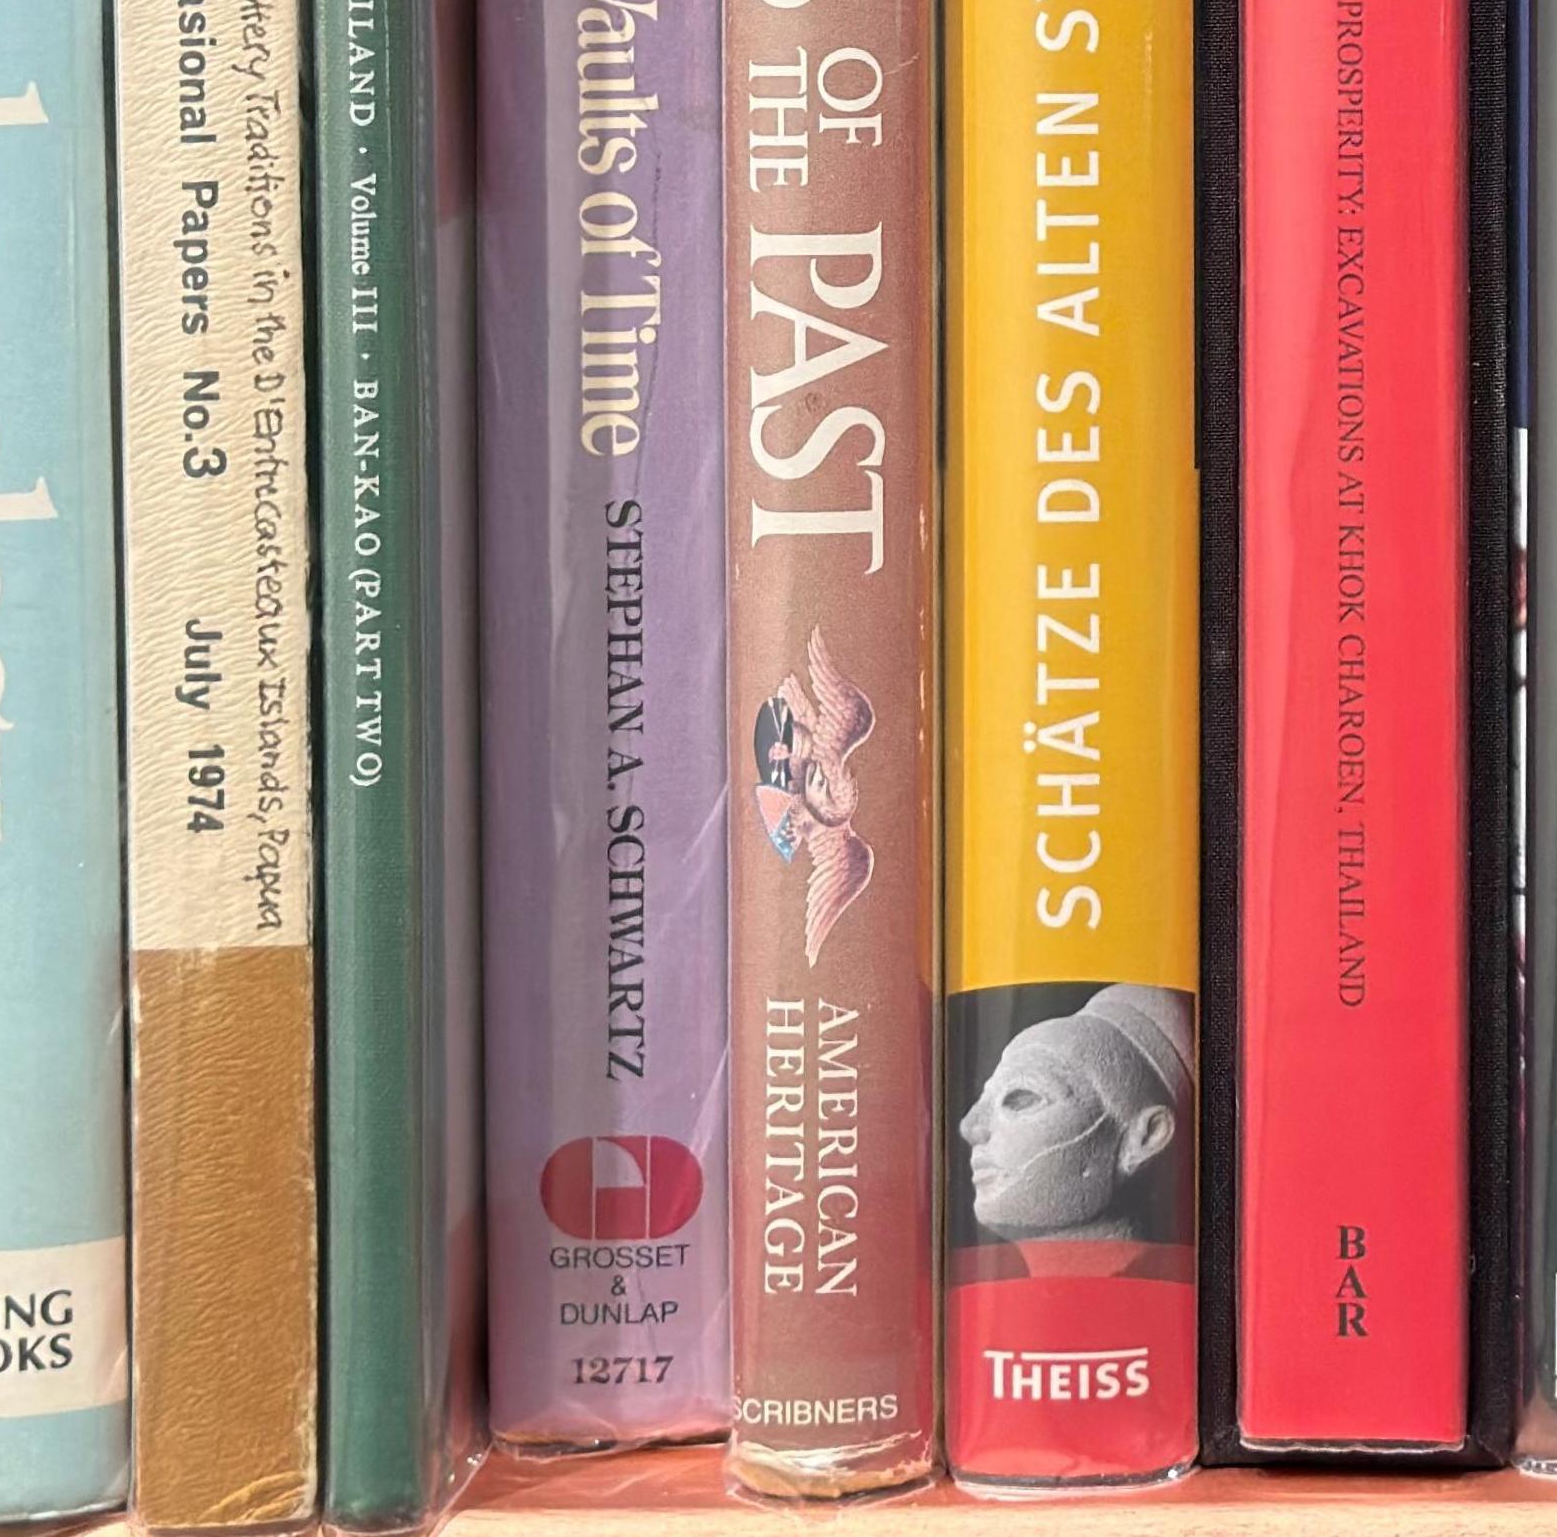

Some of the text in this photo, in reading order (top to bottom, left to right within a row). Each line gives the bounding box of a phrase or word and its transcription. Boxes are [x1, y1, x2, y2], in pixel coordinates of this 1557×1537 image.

[747, 46, 809, 193] THE
[817, 46, 884, 147] OF
[1336, 0, 1365, 216] PROSPERITY:
[172, 179, 223, 336] Papers
[350, 172, 378, 335] Volume III
[577, 191, 662, 268] of
[1036, 91, 1101, 337] ALTEN
[577, 273, 663, 456] Time
[749, 220, 889, 576] PAST
[1337, 225, 1365, 463] EXCAVATIONS
[179, 370, 228, 480] No.3
[1036, 369, 1101, 523] DES
[1337, 470, 1365, 516] AT
[348, 379, 383, 787] BAN-KAO (PART TWO)
[1337, 523, 1365, 622] KHOK
[174, 618, 228, 711] July
[1333, 633, 1366, 814] CHAROEN,
[185, 742, 228, 835] 1974
[602, 498, 647, 1081] STEPHAN A. SCHWARTZ
[1022, 562, 1103, 929] SCHÄTZE
[1337, 821, 1366, 1008] THAILAND
[763, 995, 806, 1294] HERITAGE
[814, 996, 859, 1297] AMERICAN
[1335, 1224, 1368, 1337] BAR
[571, 1355, 674, 1385] 12717
[982, 1347, 1150, 1400] THEISS
